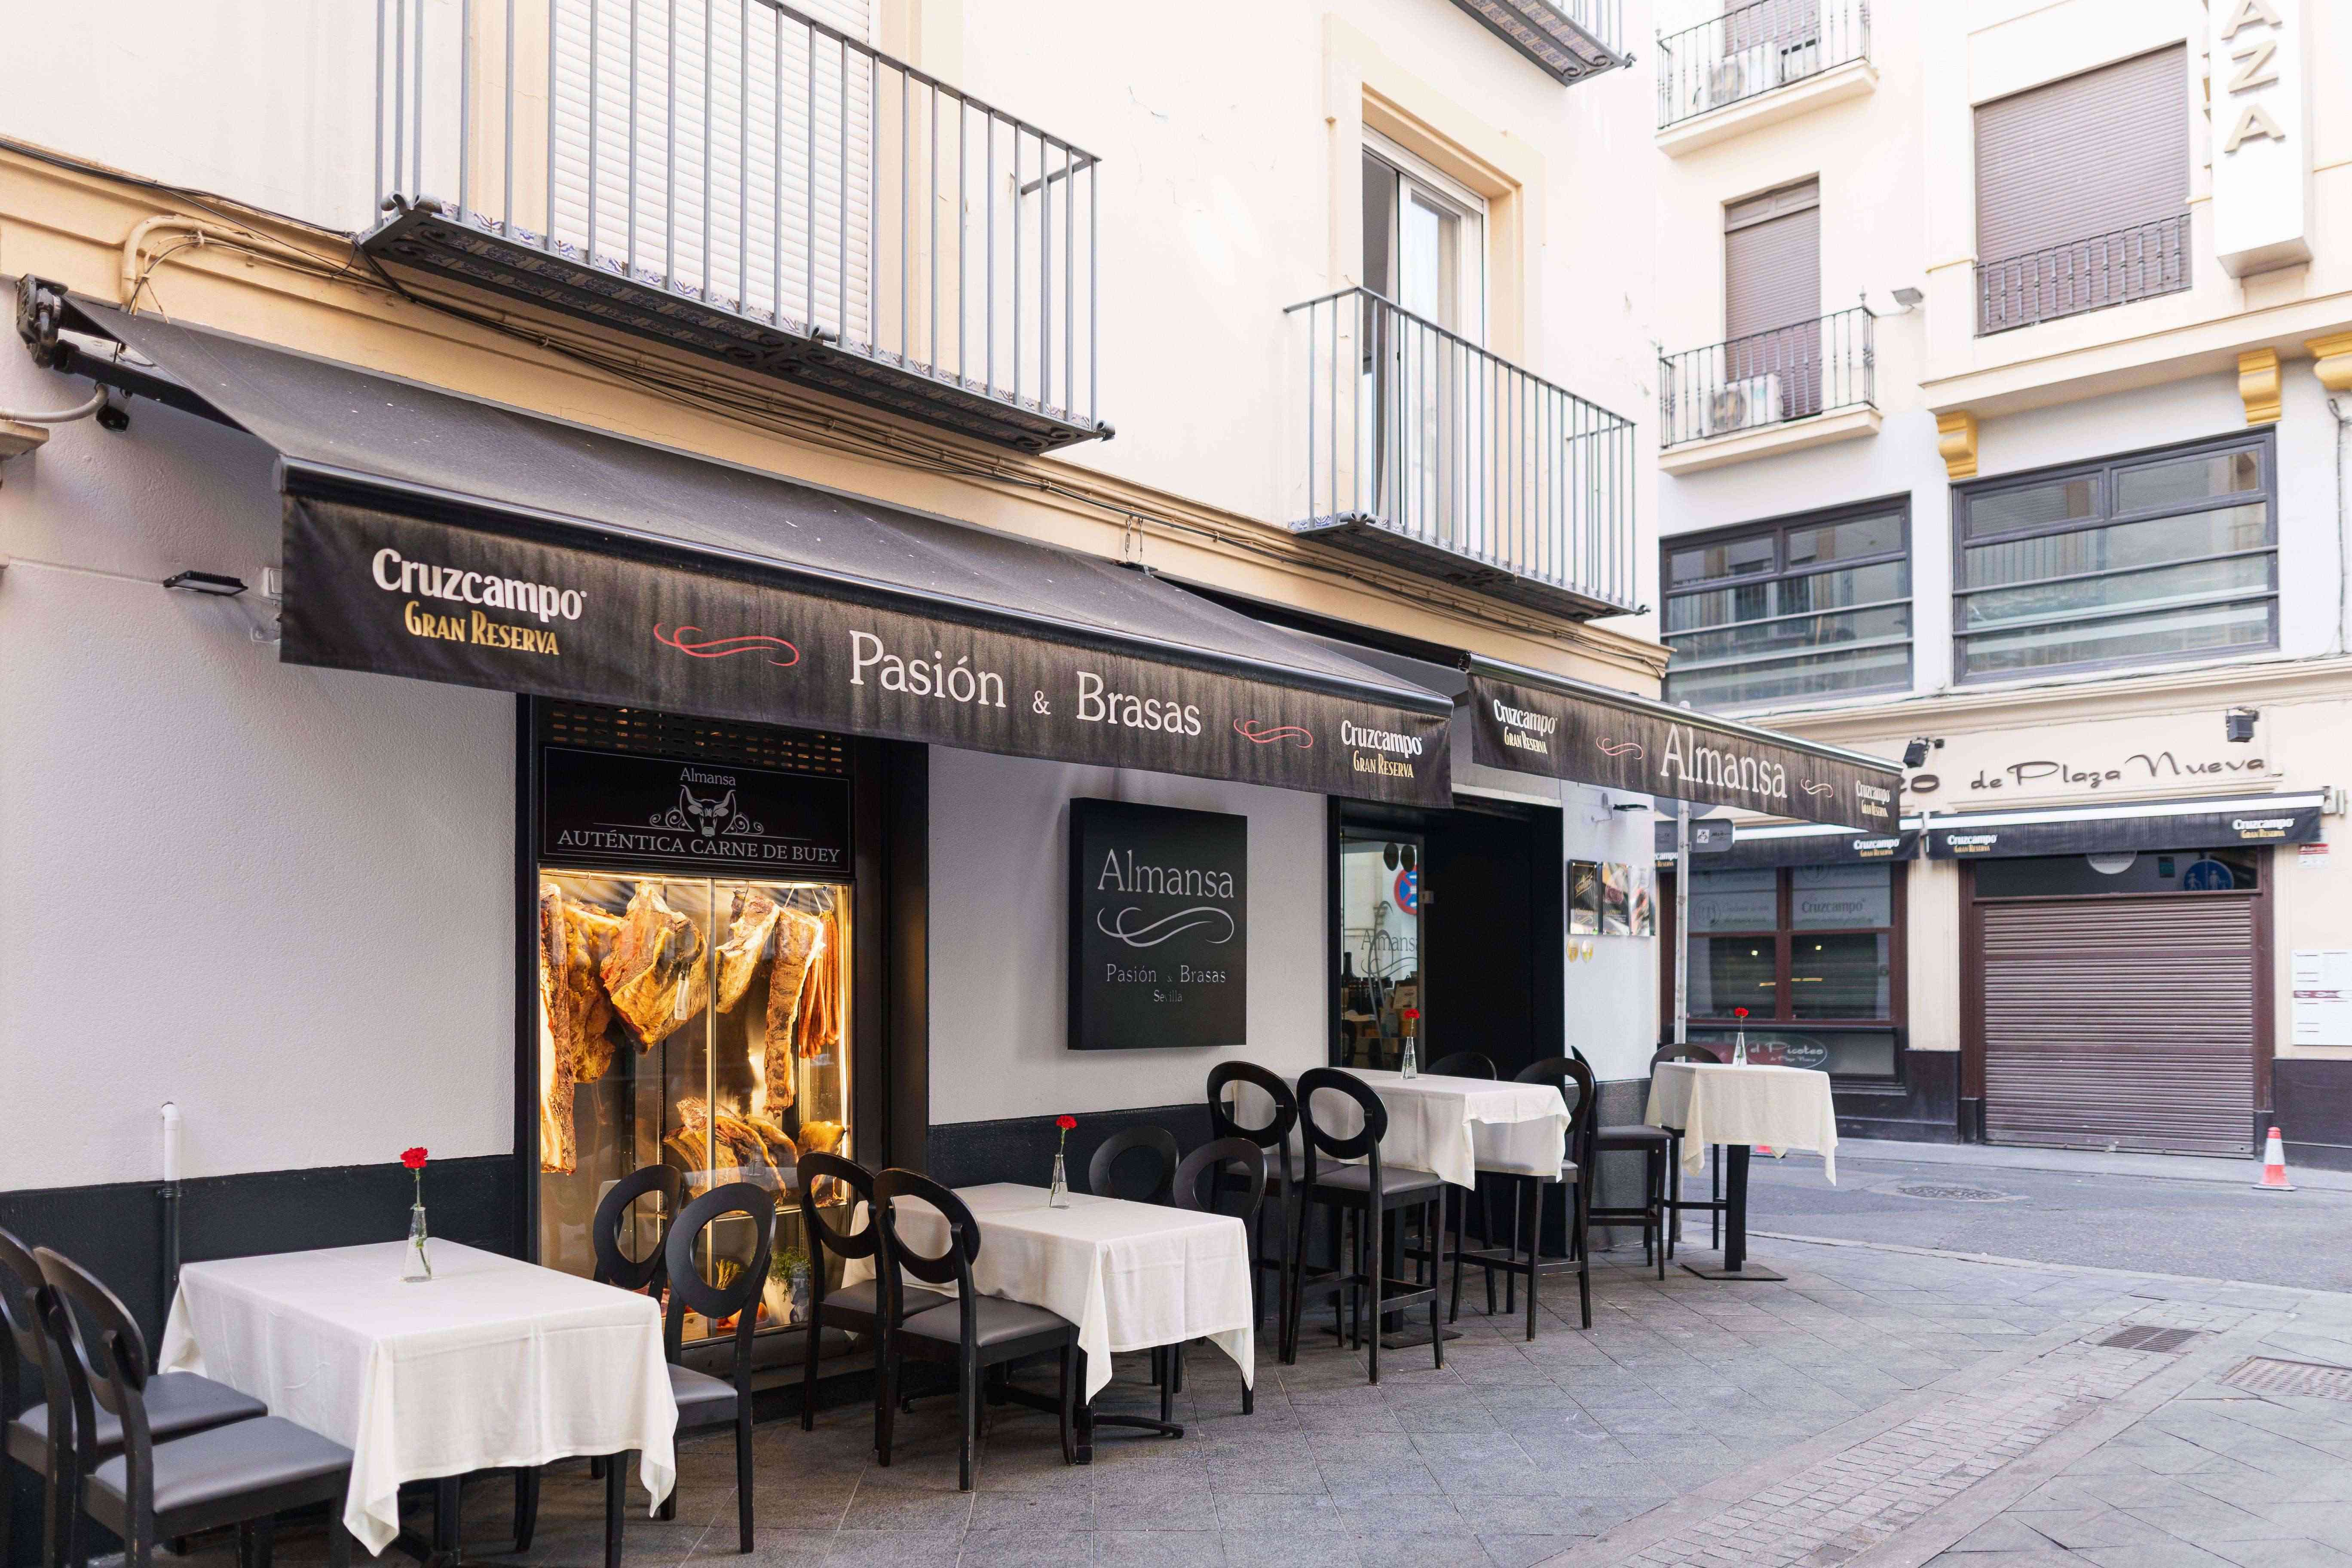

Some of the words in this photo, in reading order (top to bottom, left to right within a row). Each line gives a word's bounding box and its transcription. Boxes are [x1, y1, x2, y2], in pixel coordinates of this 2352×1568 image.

[372, 548, 584, 623] Cruzcampo
[404, 600, 466, 642] GRAN
[471, 610, 560, 655] RESERVA
[849, 630, 1007, 709] Pasión
[1032, 690, 1051, 715] &
[1076, 671, 1202, 736] Brasas
[1493, 699, 1556, 737] Cruzcampo
[1341, 720, 1423, 759] Cruzcampo
[1504, 726, 1522, 748] GRAN
[1521, 730, 1548, 754] RESERVA
[680, 767, 736, 786] Almansa
[1353, 750, 1376, 774] GRAN
[1378, 753, 1414, 778] RESERVA
[1660, 723, 1787, 799] Almansa
[1970, 771, 2003, 790] de
[2007, 761, 2122, 788] Plaza
[2125, 751, 2265, 777] Nueva
[1856, 780, 1890, 805] Cruzcampo
[1947, 834, 1997, 845] Cruzcampo
[2232, 818, 2294, 830] Cruzcampo
[557, 829, 686, 853] AUTÉNTICA
[690, 839, 758, 858] CARNE
[763, 844, 787, 860] DE
[792, 847, 840, 863] BUEY
[1853, 839, 1899, 850] Cruzcampo
[1097, 848, 1234, 898] Almansa
[1801, 900, 1864, 913] Cruzcampo
[1106, 964, 1157, 983] Pasión
[1180, 965, 1226, 983] Brasas
